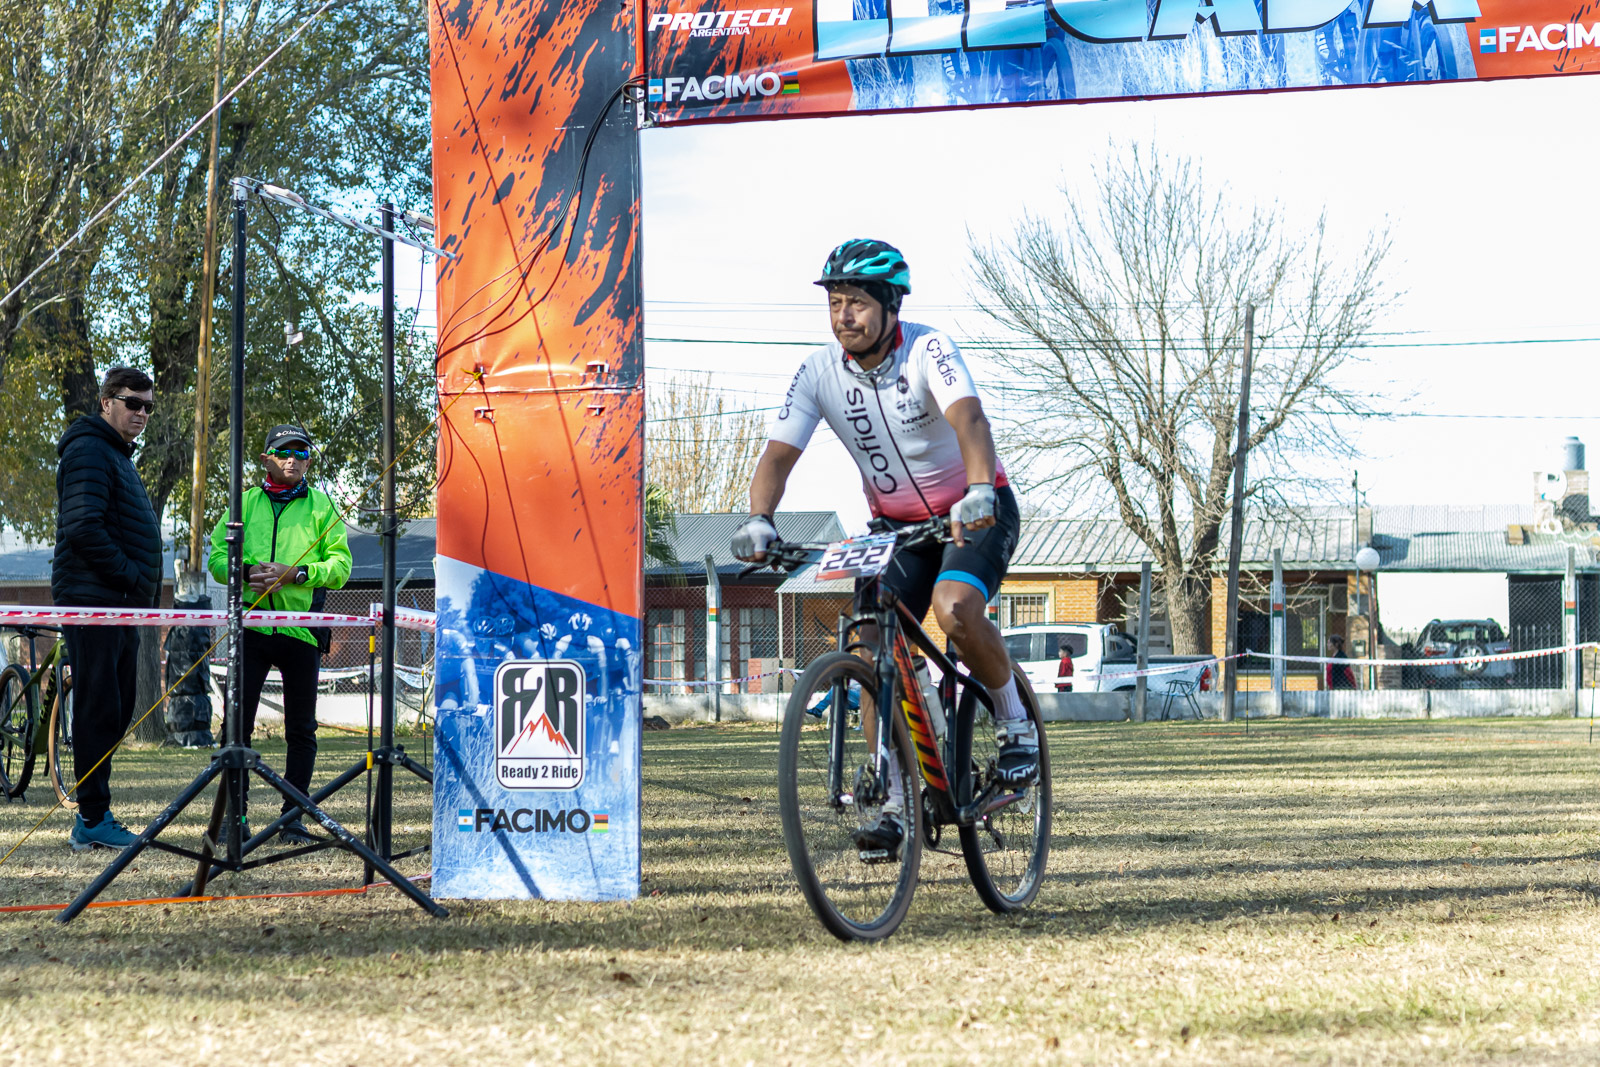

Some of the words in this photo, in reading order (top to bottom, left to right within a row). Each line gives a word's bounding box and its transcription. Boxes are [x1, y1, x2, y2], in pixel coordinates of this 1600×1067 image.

[648, 7, 793, 31] PROTECH
[689, 27, 750, 37] ARGENTINA
[665, 72, 781, 102] FACIMO
[844, 387, 898, 495] Cofidis
[822, 545, 888, 571] 222
[501, 765, 538, 779] Ready
[541, 766, 549, 778] 2
[552, 765, 578, 778] Ride
[475, 808, 590, 833] FACIMO
